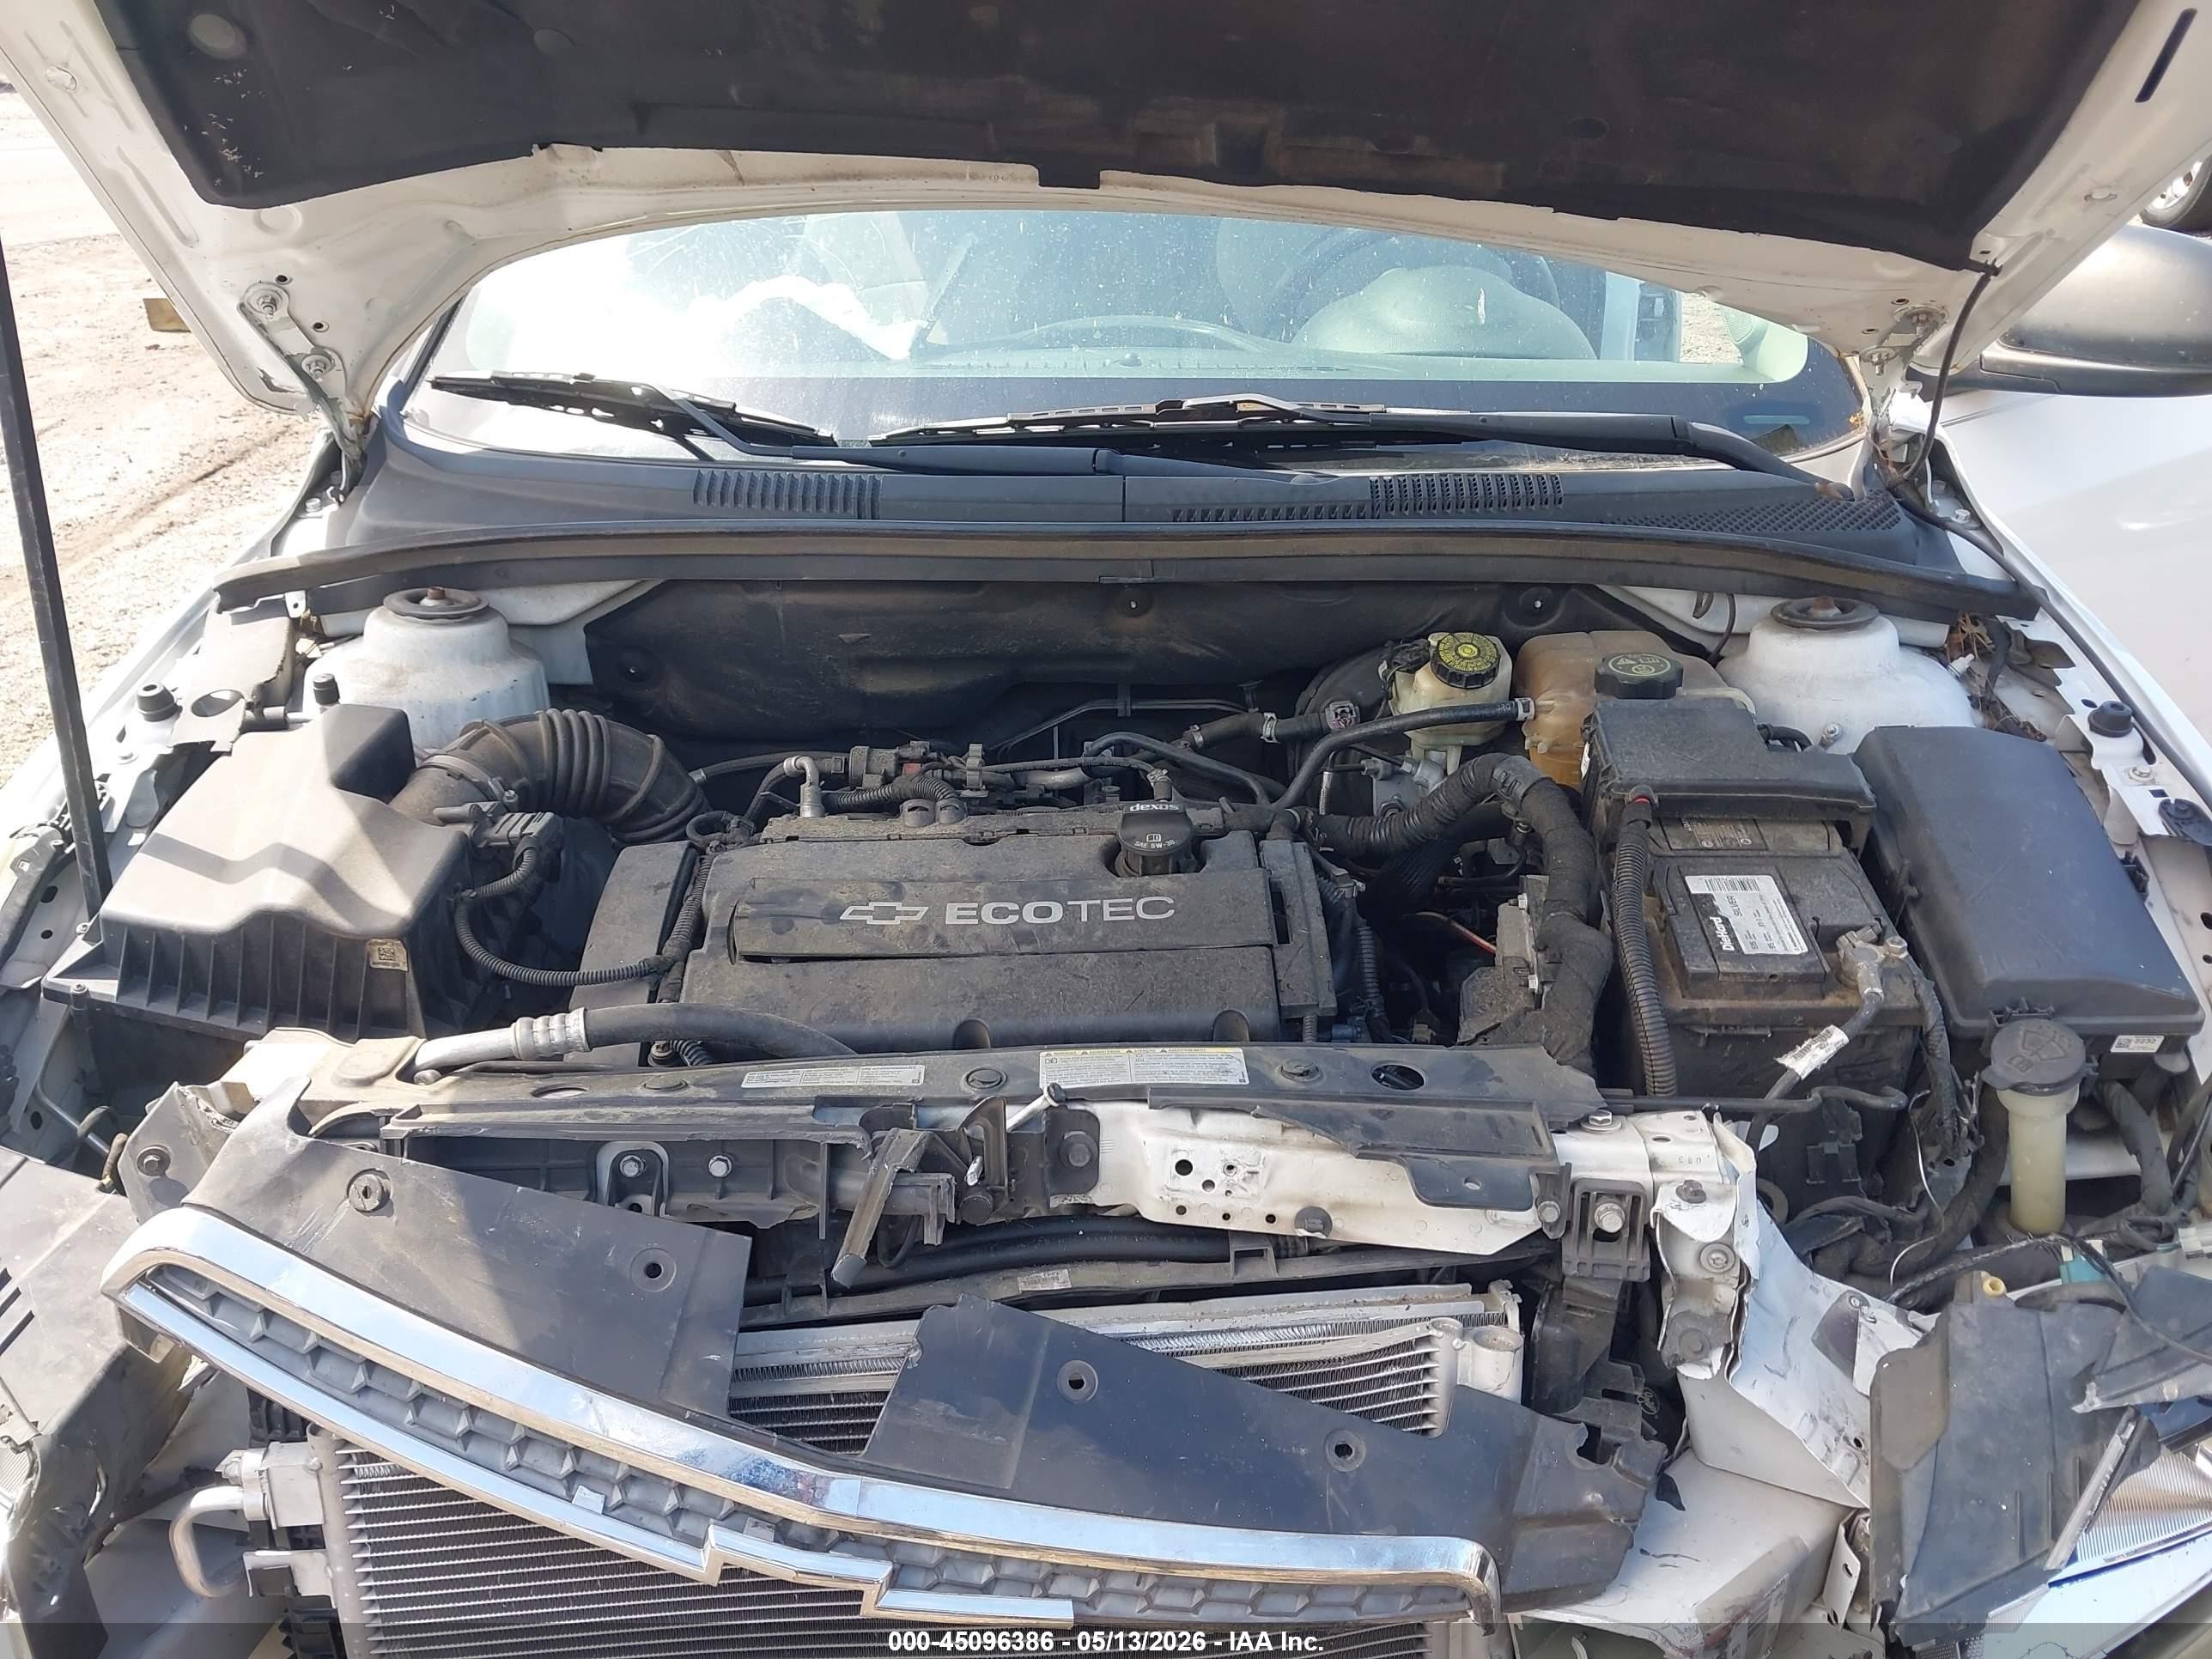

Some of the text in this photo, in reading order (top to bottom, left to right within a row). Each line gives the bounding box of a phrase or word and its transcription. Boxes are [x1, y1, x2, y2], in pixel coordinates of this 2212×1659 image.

[1129, 803, 1179, 811] dexos
[945, 896, 1175, 925] ECOTEC
[1709, 916, 1735, 951] DieHard
